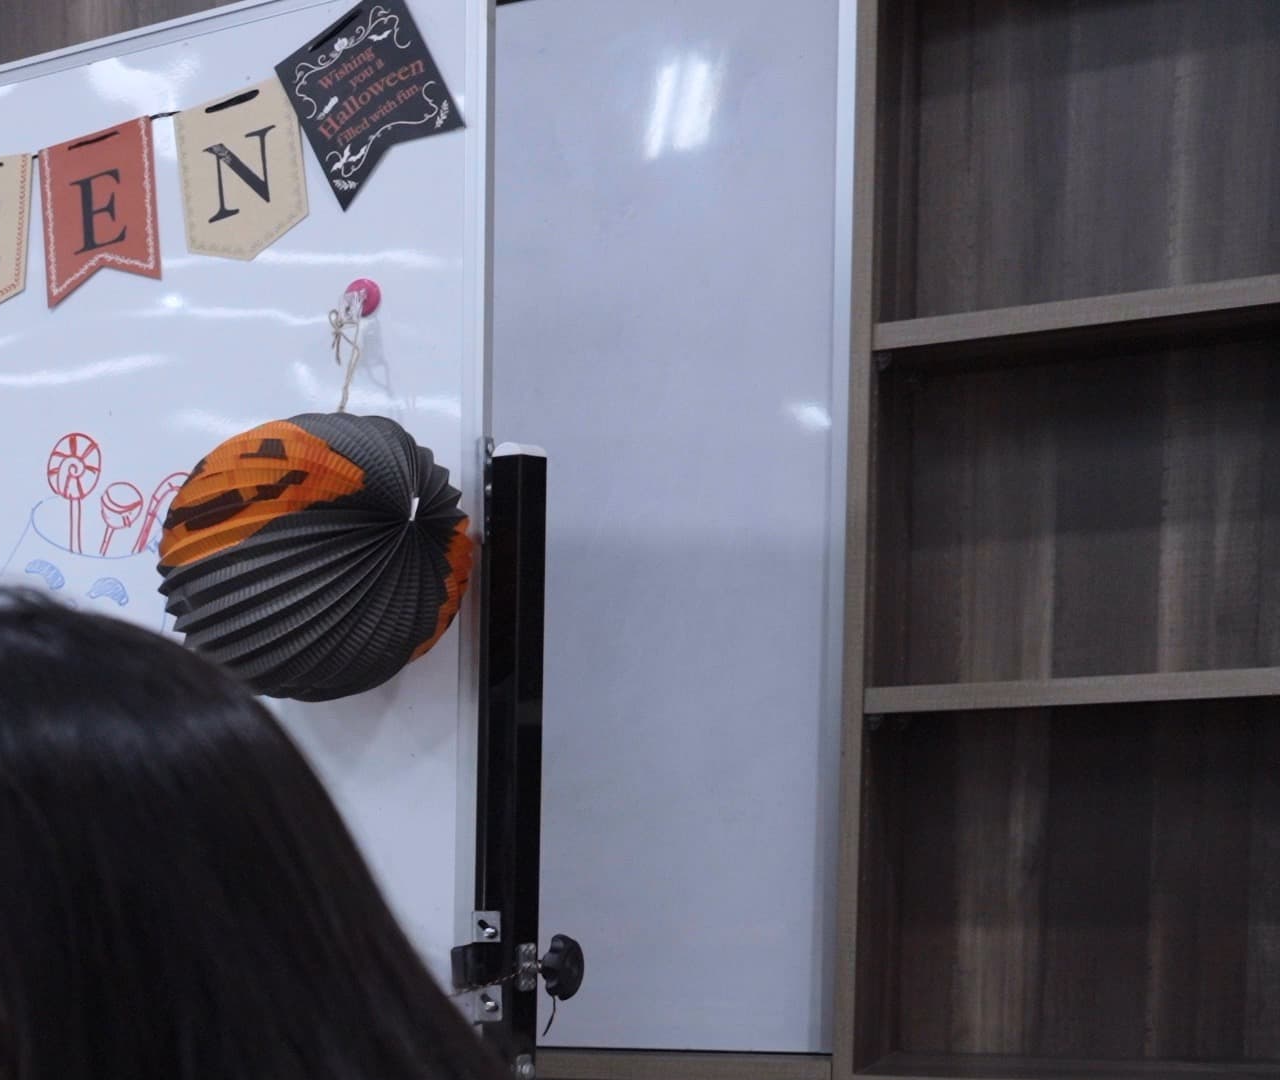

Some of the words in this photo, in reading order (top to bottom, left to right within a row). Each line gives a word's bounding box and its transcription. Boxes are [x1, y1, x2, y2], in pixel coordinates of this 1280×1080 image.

[317, 45, 377, 91] Wishing
[349, 66, 375, 89] you
[317, 57, 426, 141] Halloween
[335, 118, 370, 147] filled
[369, 100, 397, 123] with
